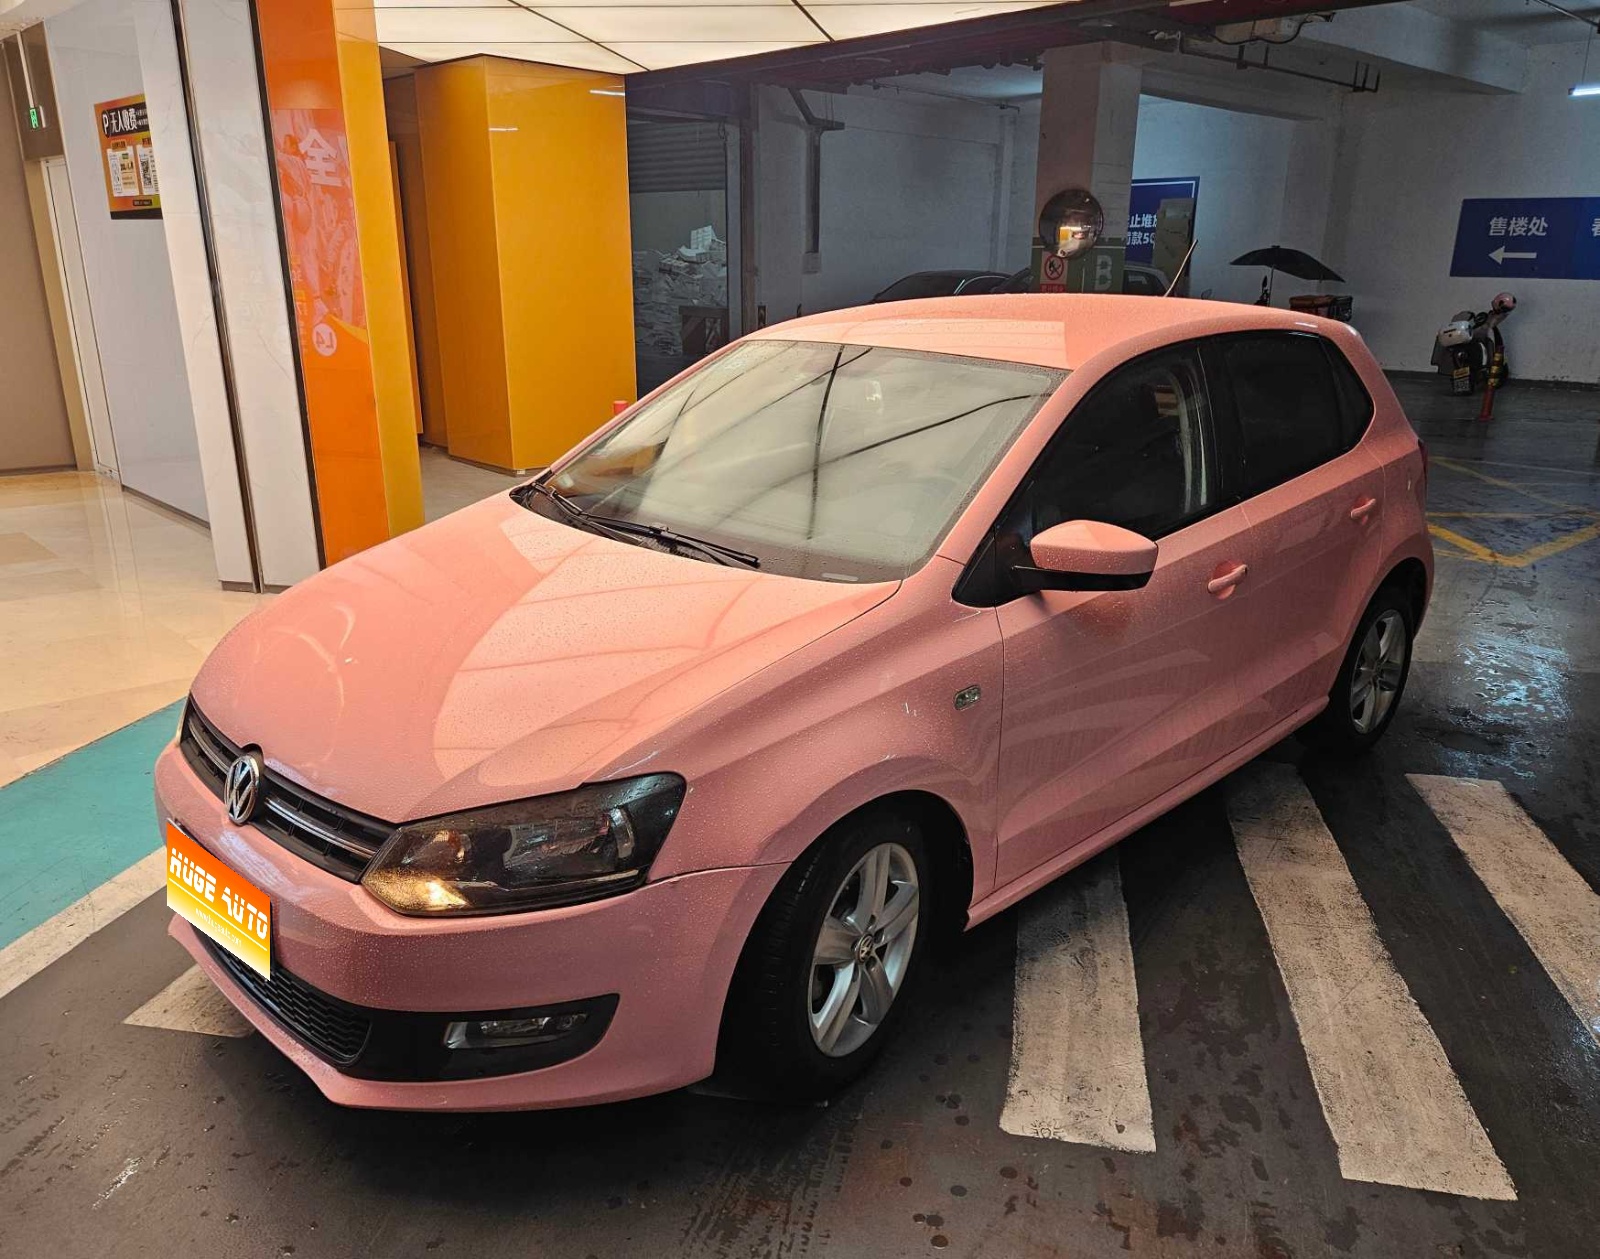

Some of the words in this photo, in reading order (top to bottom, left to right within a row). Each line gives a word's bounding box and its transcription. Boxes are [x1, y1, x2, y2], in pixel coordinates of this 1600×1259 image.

[102, 113, 109, 135] P
[109, 108, 138, 133] 无人收费
[1128, 213, 1158, 228] 止堆
[1488, 216, 1549, 236] 售楼处
[1095, 255, 1112, 291] B
